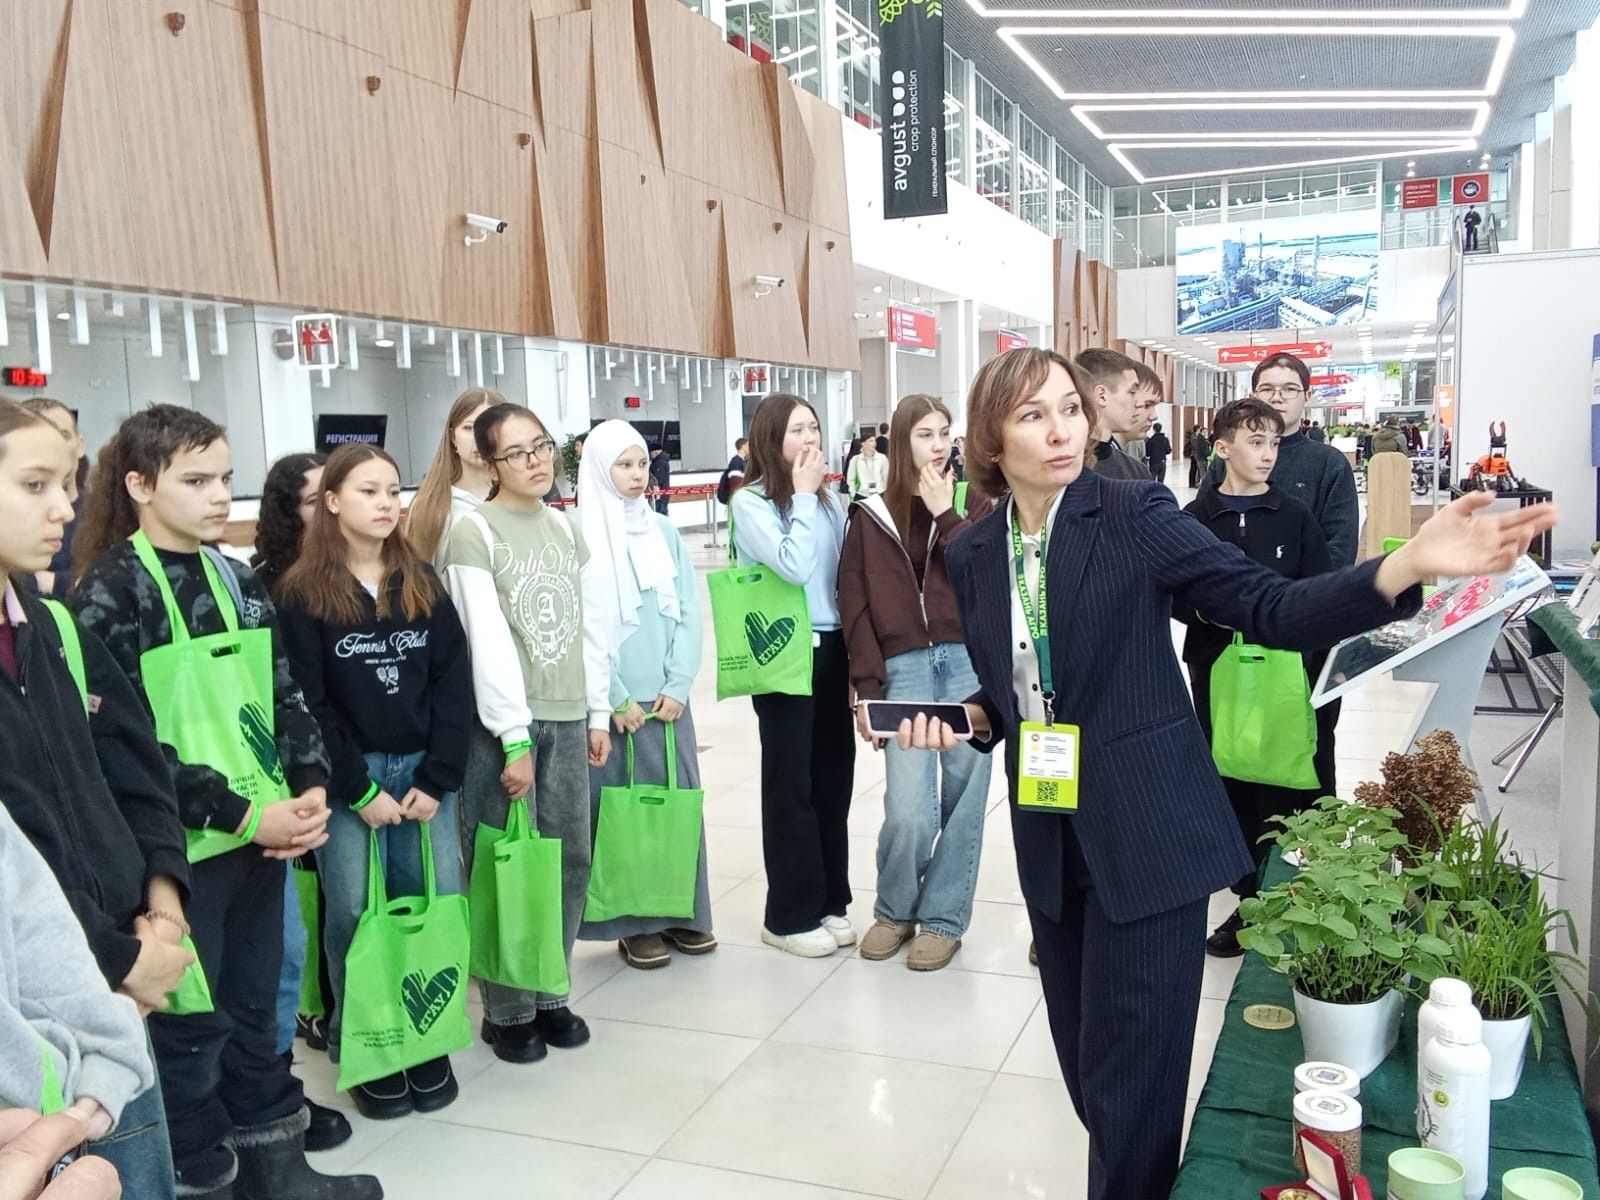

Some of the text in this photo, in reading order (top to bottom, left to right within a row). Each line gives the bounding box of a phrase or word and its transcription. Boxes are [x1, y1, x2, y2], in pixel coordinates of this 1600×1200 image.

[908, 69, 920, 152] crop protection
[890, 120, 911, 191] avgust
[1028, 616, 1040, 639] АГРО
[1038, 590, 1048, 628] КАЗАНЬ
[335, 630, 428, 657] Tennis Club
